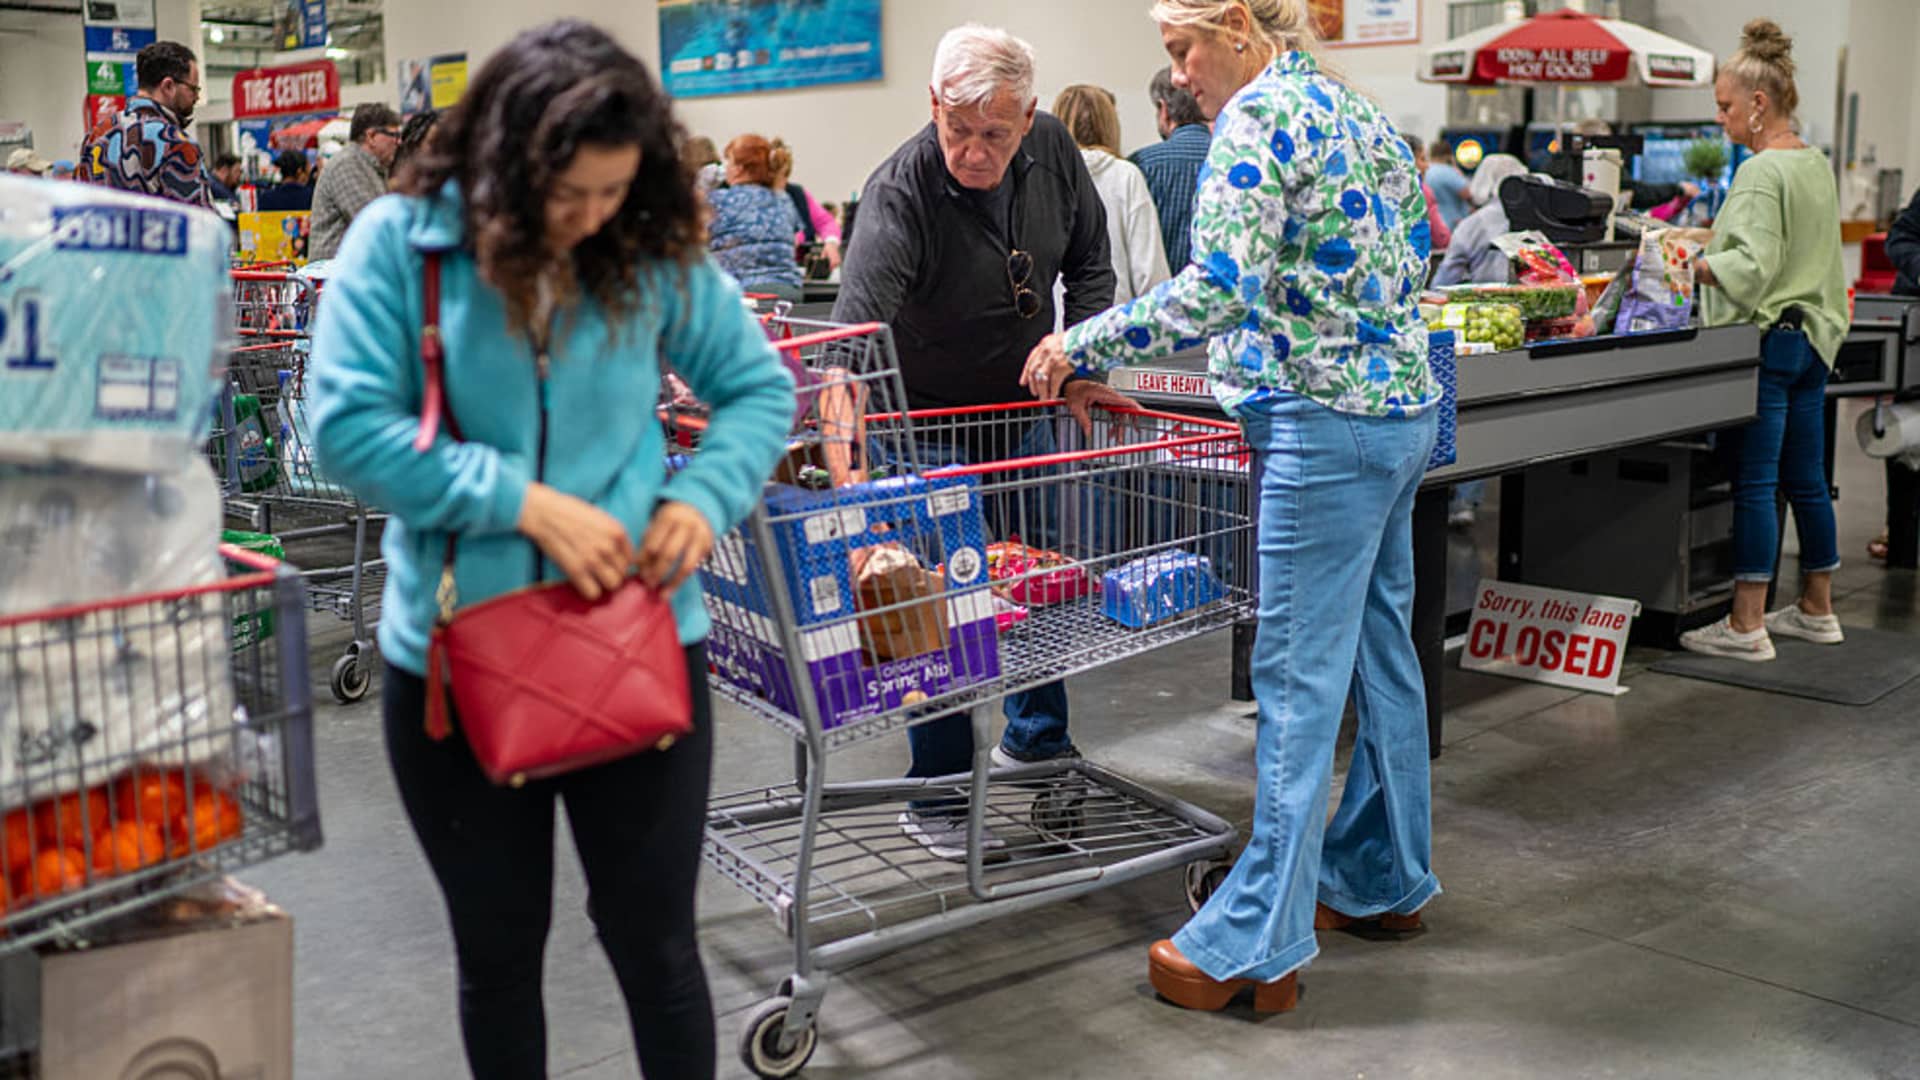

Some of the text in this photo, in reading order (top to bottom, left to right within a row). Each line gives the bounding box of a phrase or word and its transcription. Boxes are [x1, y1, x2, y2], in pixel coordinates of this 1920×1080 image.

[1537, 47, 1567, 63] ALL
[1572, 48, 1609, 65] BEEF
[1508, 62, 1594, 78] HOT DOGS
[243, 70, 327, 112] TIRE CENTER
[1137, 373, 1169, 391] LEAVE
[1170, 375, 1206, 394] HEAVY
[1479, 589, 1627, 631] Sorry, this lane
[1468, 617, 1618, 680] CLOSED
[867, 671, 922, 698] Spring
